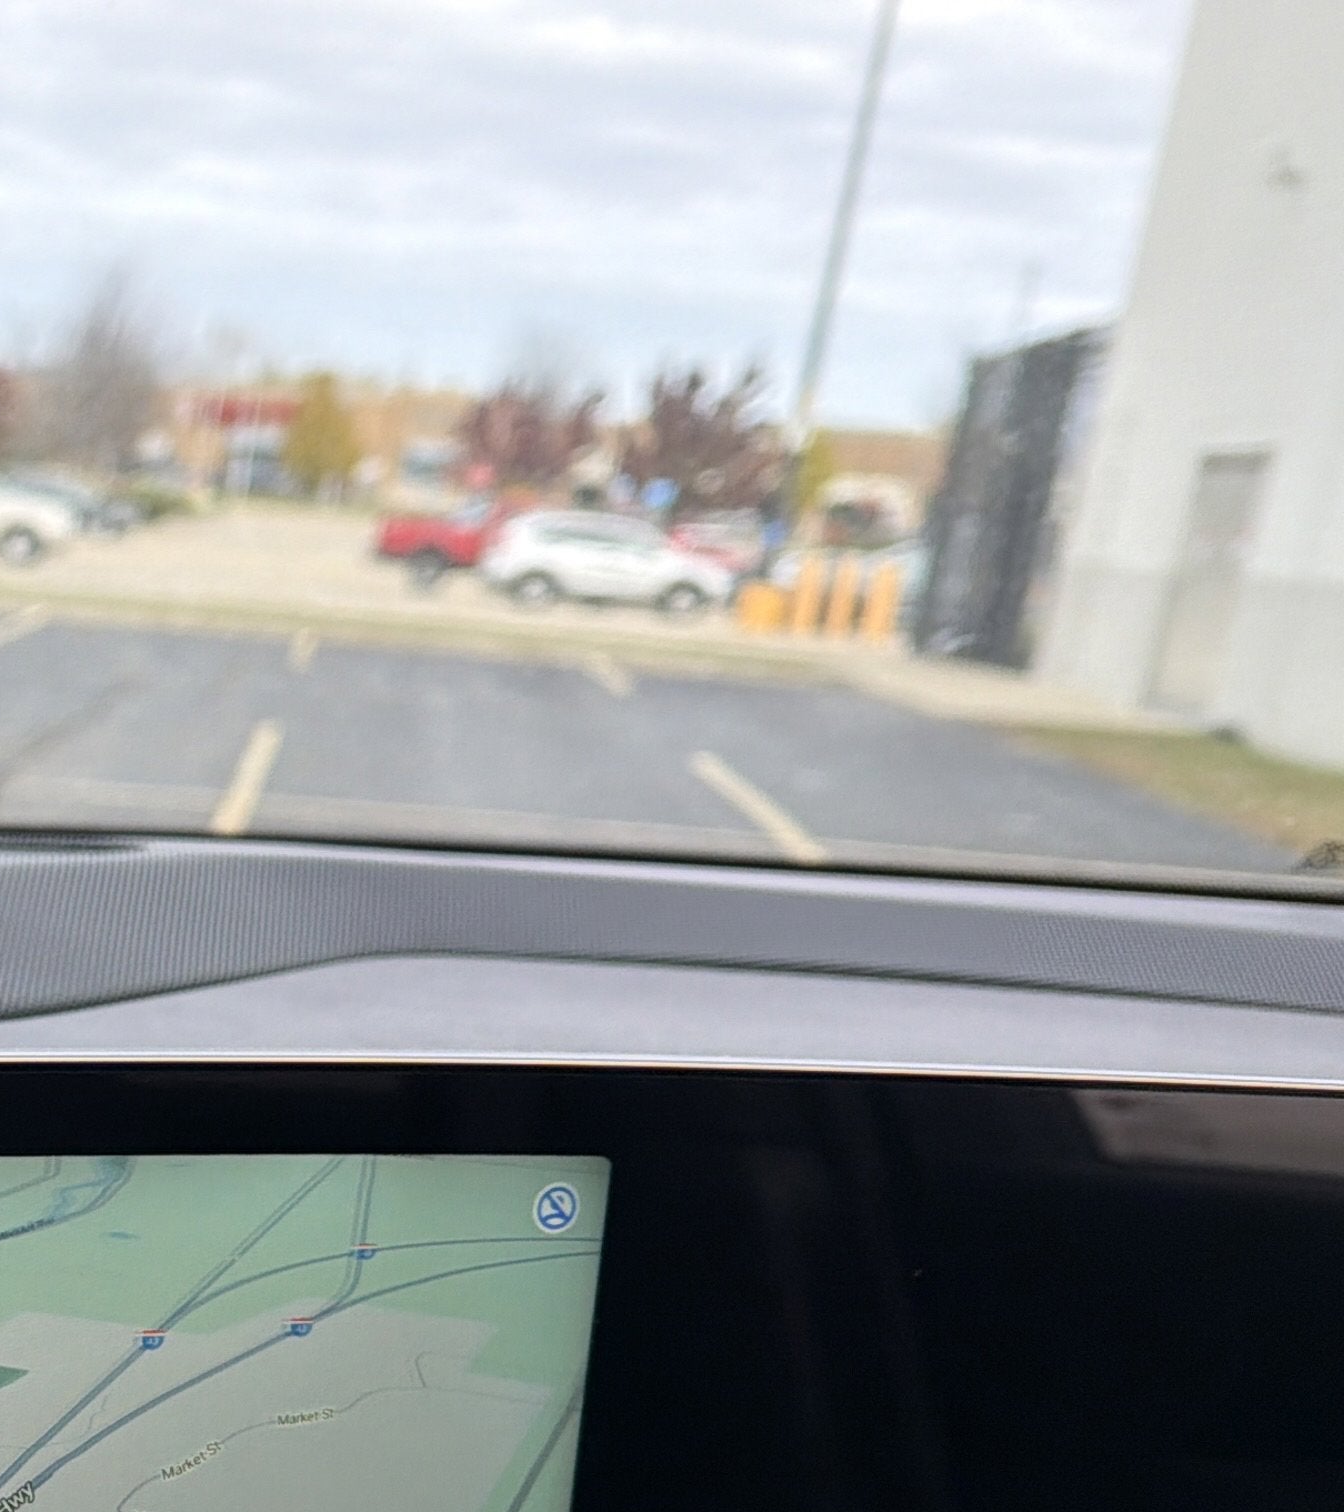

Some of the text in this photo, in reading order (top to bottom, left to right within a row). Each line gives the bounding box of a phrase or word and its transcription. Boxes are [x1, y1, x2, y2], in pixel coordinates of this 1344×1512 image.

[278, 1408, 335, 1425] Market St
[162, 1441, 222, 1480] Market St
